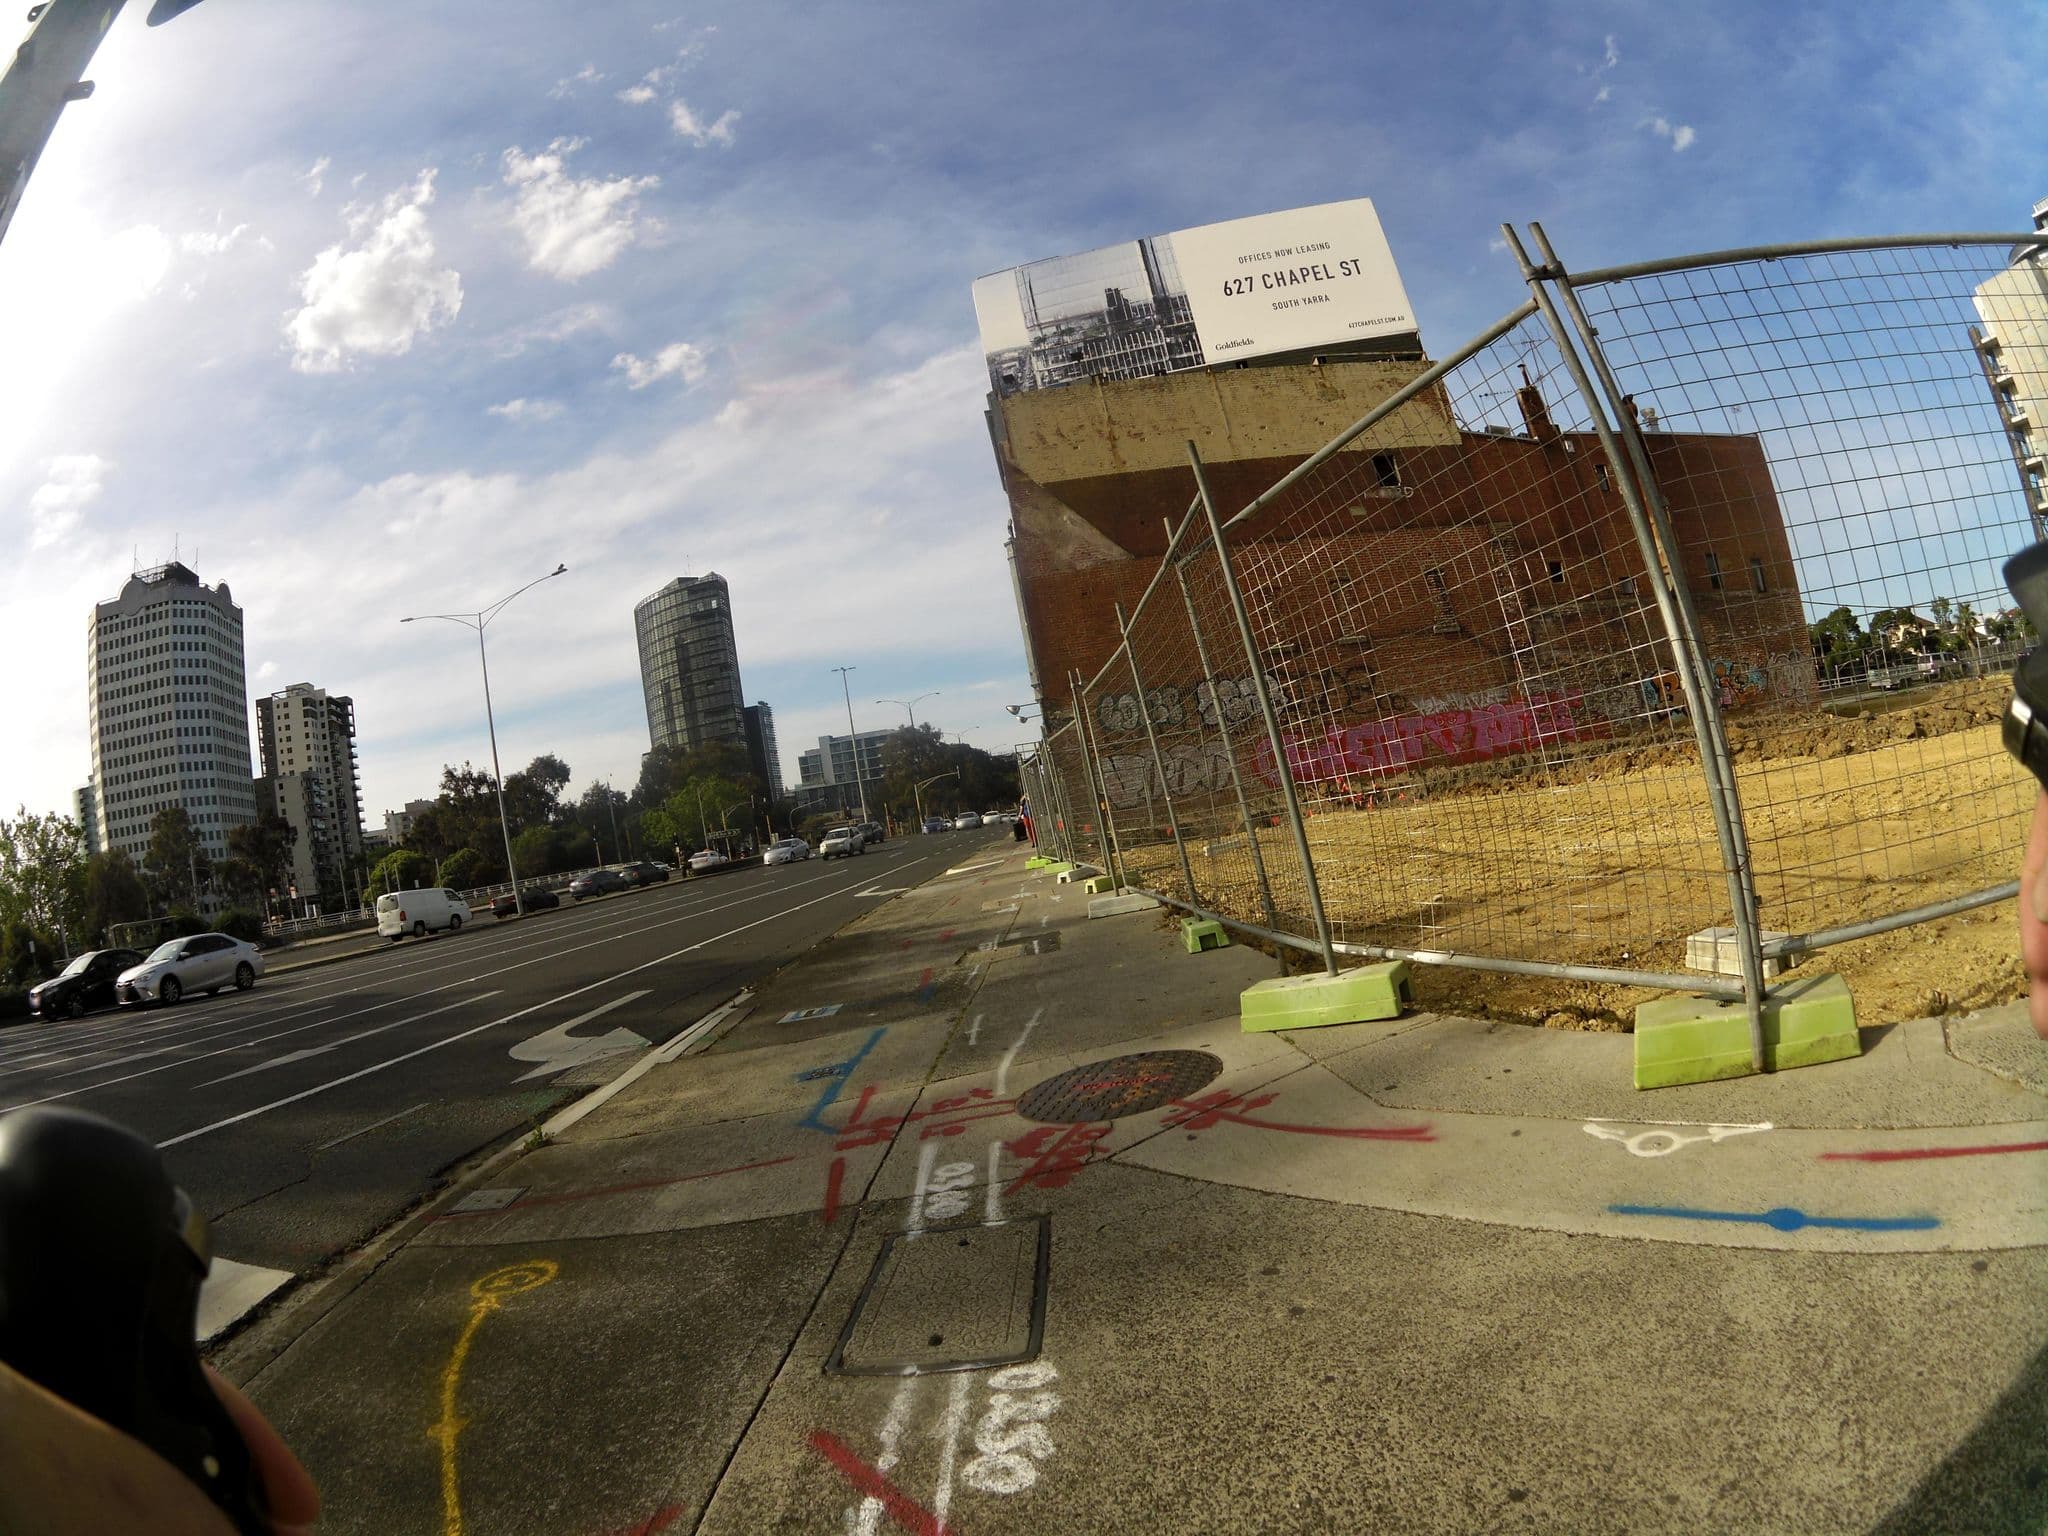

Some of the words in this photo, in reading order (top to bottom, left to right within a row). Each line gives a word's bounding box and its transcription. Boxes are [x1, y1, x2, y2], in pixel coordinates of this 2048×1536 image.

[1238, 251, 1272, 264] OFFICES
[1274, 248, 1293, 258] NOW
[1295, 242, 1331, 255] LEASING
[1223, 276, 1254, 297] 627
[1261, 263, 1336, 290] CHAPEL
[1339, 258, 1362, 277] ST
[1272, 299, 1300, 311] SOUTH
[1301, 294, 1330, 305] YARRA
[1215, 338, 1255, 351] Goldfields
